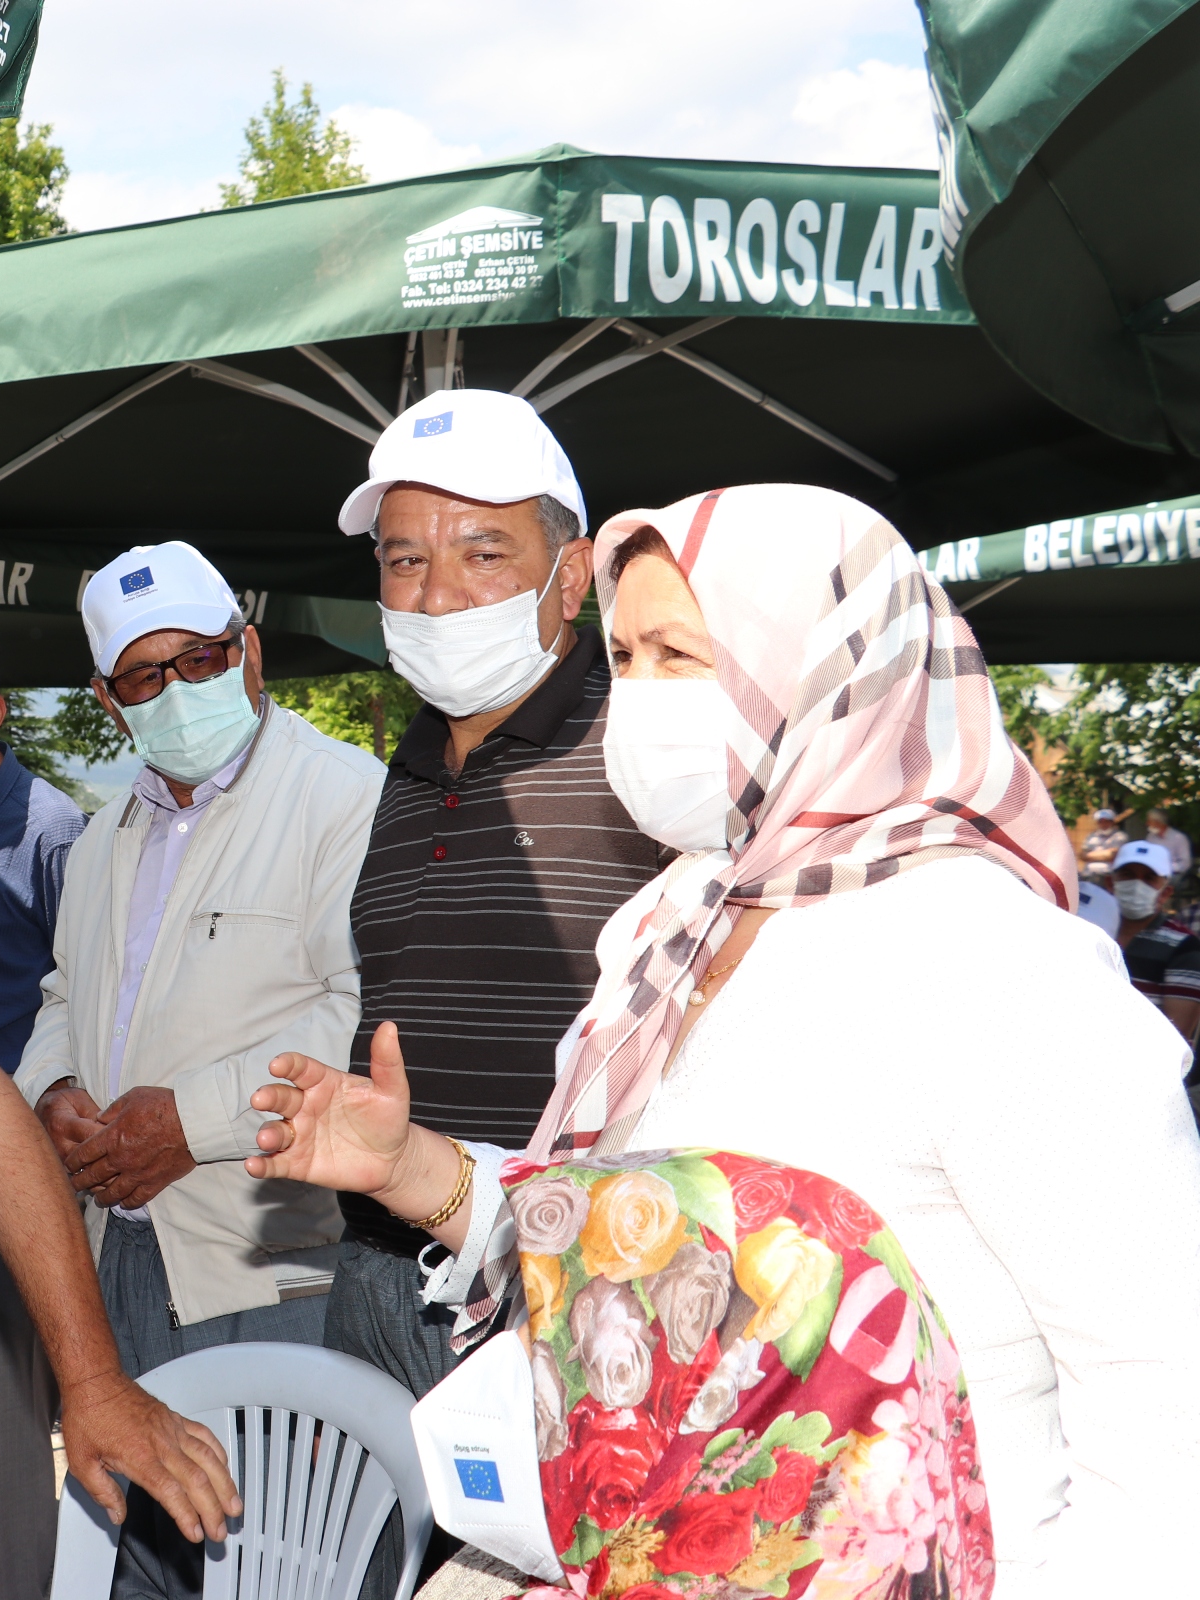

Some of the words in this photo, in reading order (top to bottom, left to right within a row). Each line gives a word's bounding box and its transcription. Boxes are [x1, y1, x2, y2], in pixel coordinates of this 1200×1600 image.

[403, 236, 456, 267] ÇETİN
[460, 227, 544, 259] ŞEMSİYE
[601, 193, 943, 311] TOROSLAR
[401, 284, 426, 299] Fab.
[428, 281, 451, 295] Tel:
[453, 278, 484, 293] 0324
[485, 276, 509, 291] 234
[511, 276, 527, 289] 42
